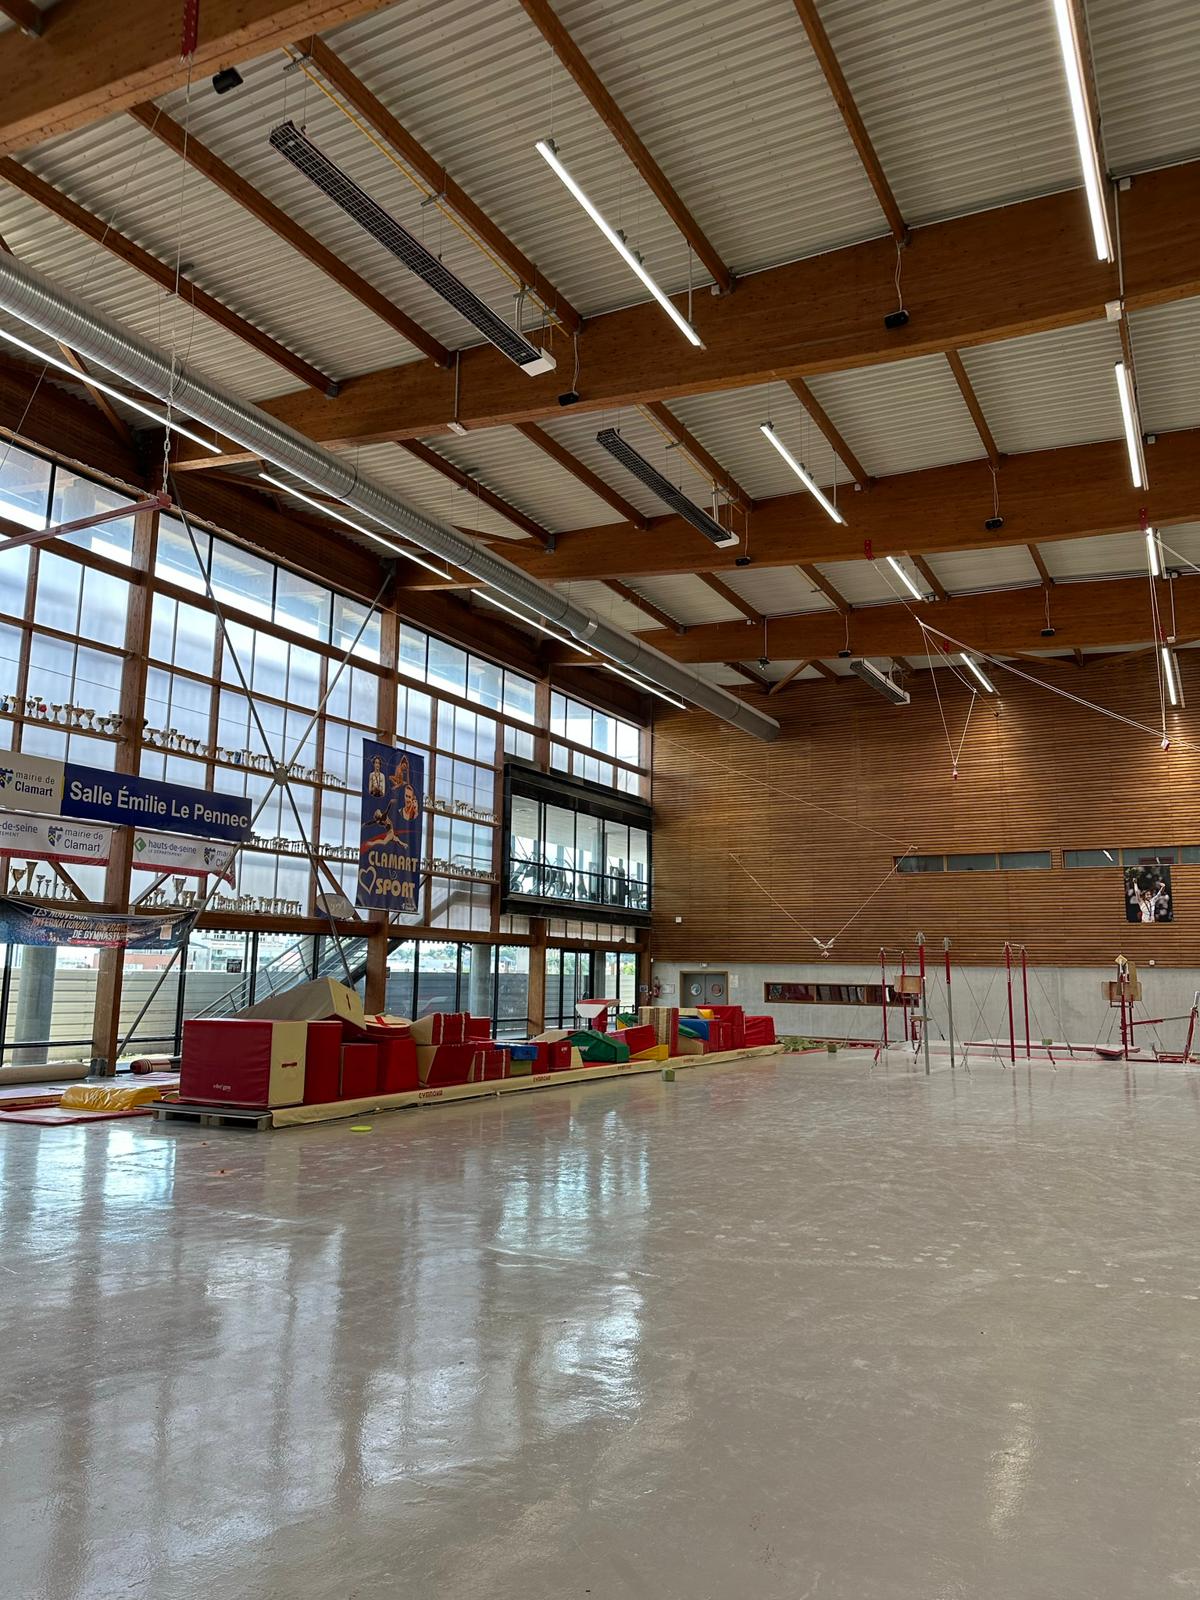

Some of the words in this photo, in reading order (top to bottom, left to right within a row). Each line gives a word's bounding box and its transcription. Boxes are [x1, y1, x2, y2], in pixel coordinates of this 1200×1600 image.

[16, 770, 43, 783] mairie
[45, 775, 55, 785] de
[15, 780, 53, 797] Clamart
[69, 780, 112, 806] Salle
[117, 785, 167, 814] Émilie
[171, 800, 190, 819] Le
[194, 803, 248, 828] Pennec
[64, 828, 91, 839] mairie
[93, 831, 103, 840] de
[64, 838, 100, 853] Clamart
[148, 839, 197, 855] hauts-de-seine
[368, 850, 418, 872] CLAMART
[375, 878, 415, 898] SPORT
[32, 907, 48, 917] LES
[32, 916, 94, 930] INTERNATIONAUX
[72, 929, 82, 939] DE
[84, 930, 126, 942] GYMNASTI
